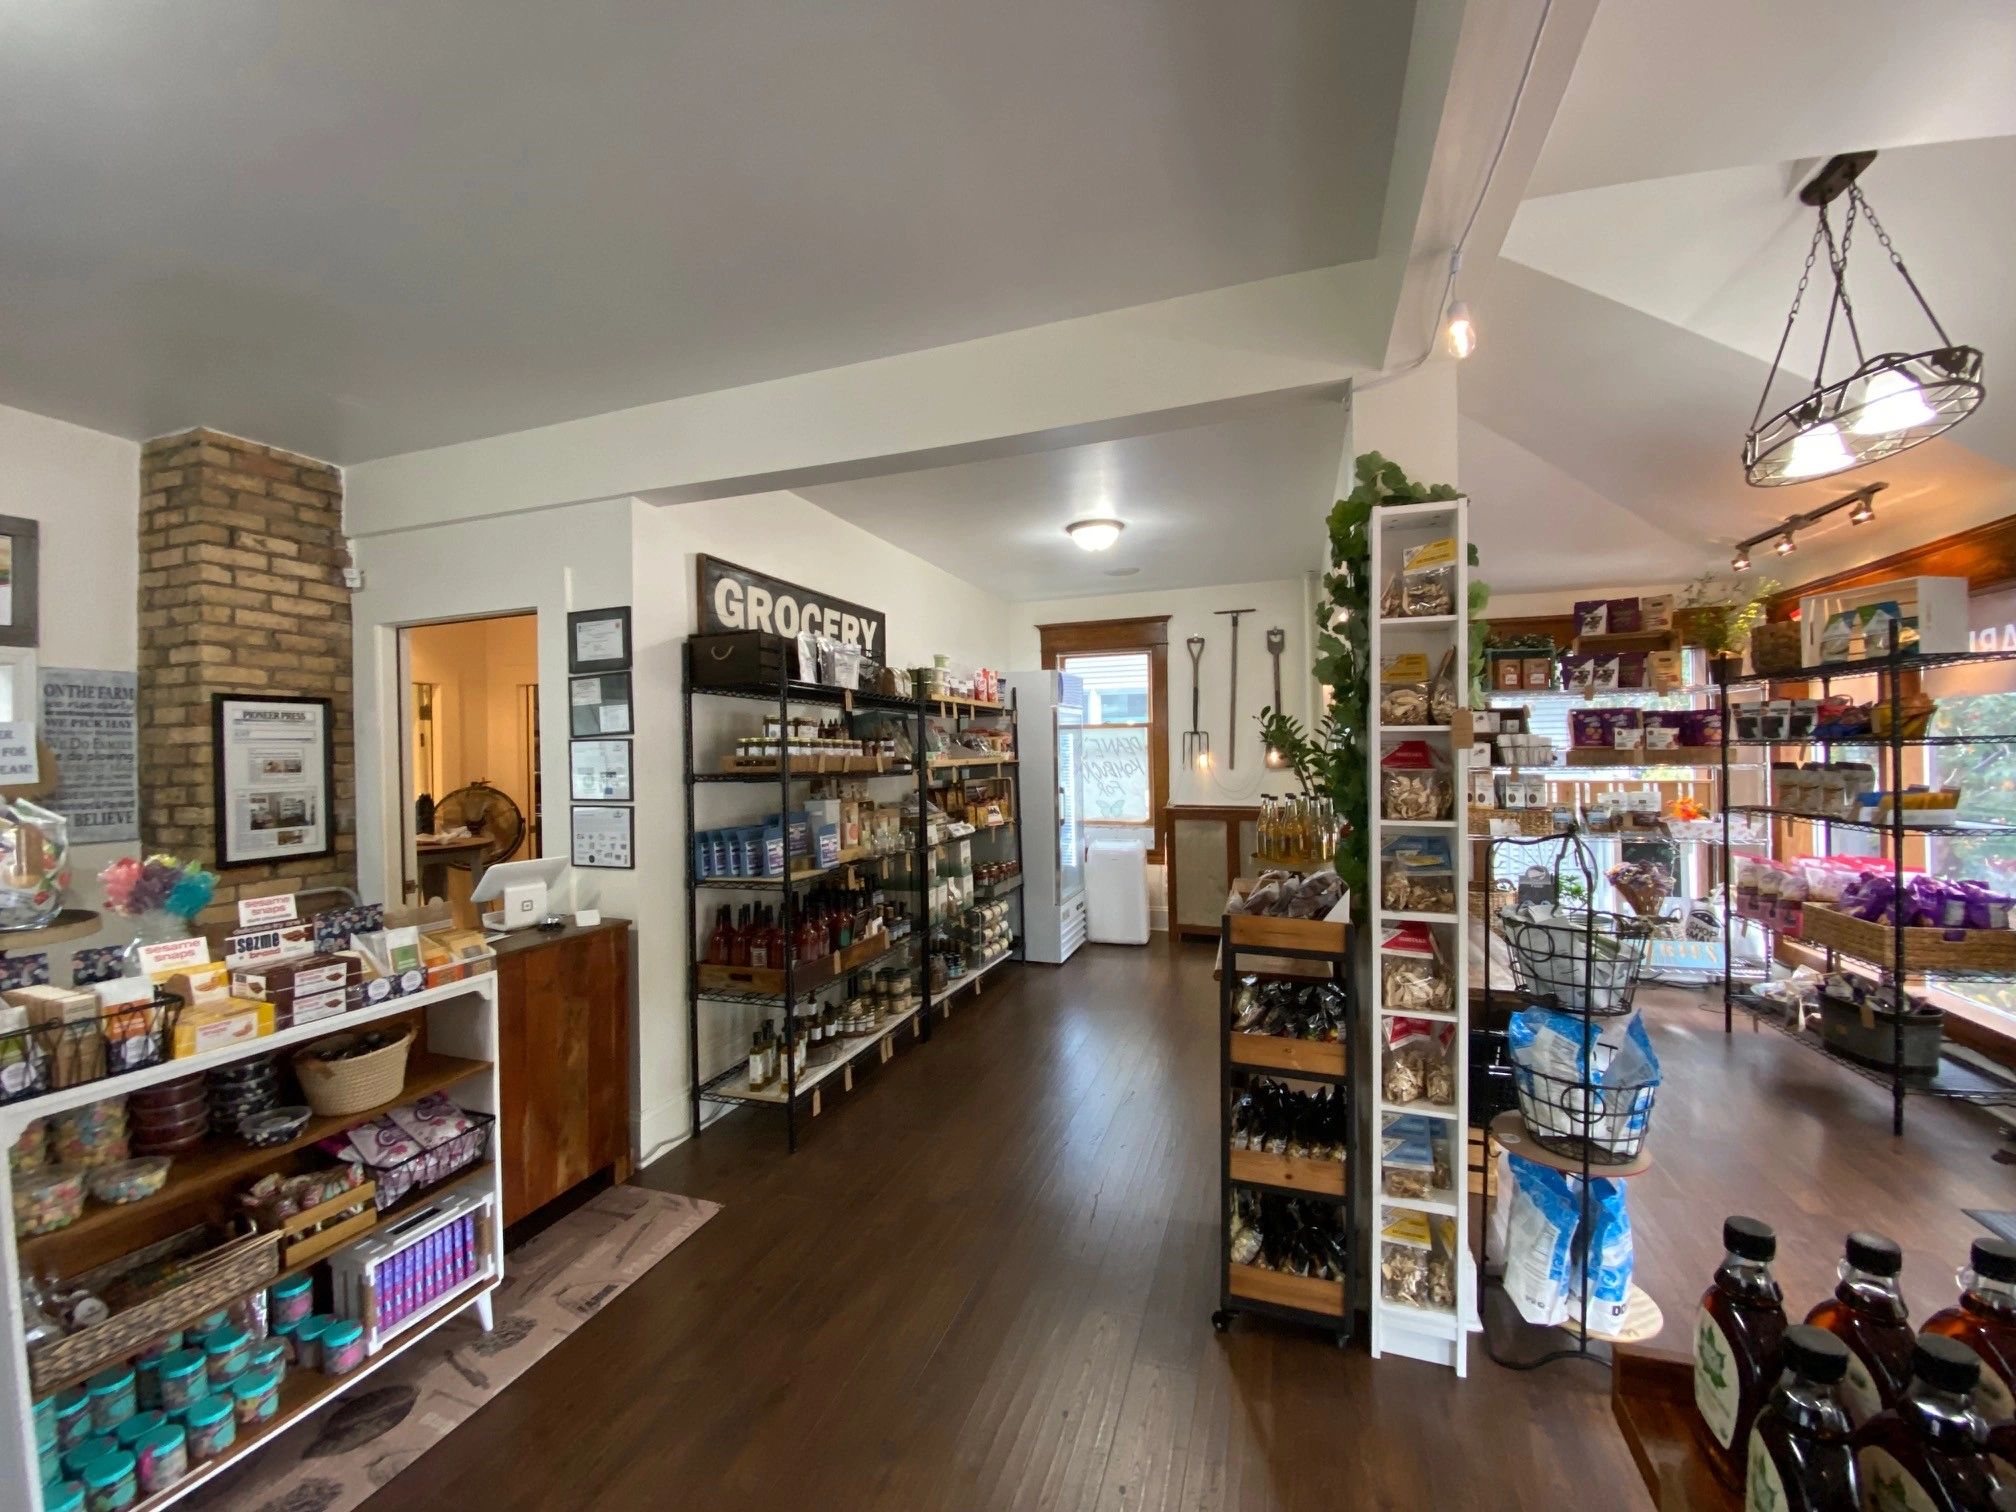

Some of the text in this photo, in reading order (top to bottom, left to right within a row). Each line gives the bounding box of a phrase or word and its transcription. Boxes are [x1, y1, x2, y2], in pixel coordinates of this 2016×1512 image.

[713, 577, 878, 657] GROCERY
[62, 684, 96, 699] THE
[98, 686, 134, 701] FARM
[243, 710, 306, 721] PIONEER PRESS
[71, 719, 102, 729] PICK
[74, 811, 135, 827] BELIEVE
[251, 905, 286, 916] snaps
[144, 940, 201, 955] sesame
[153, 949, 196, 963] snaps
